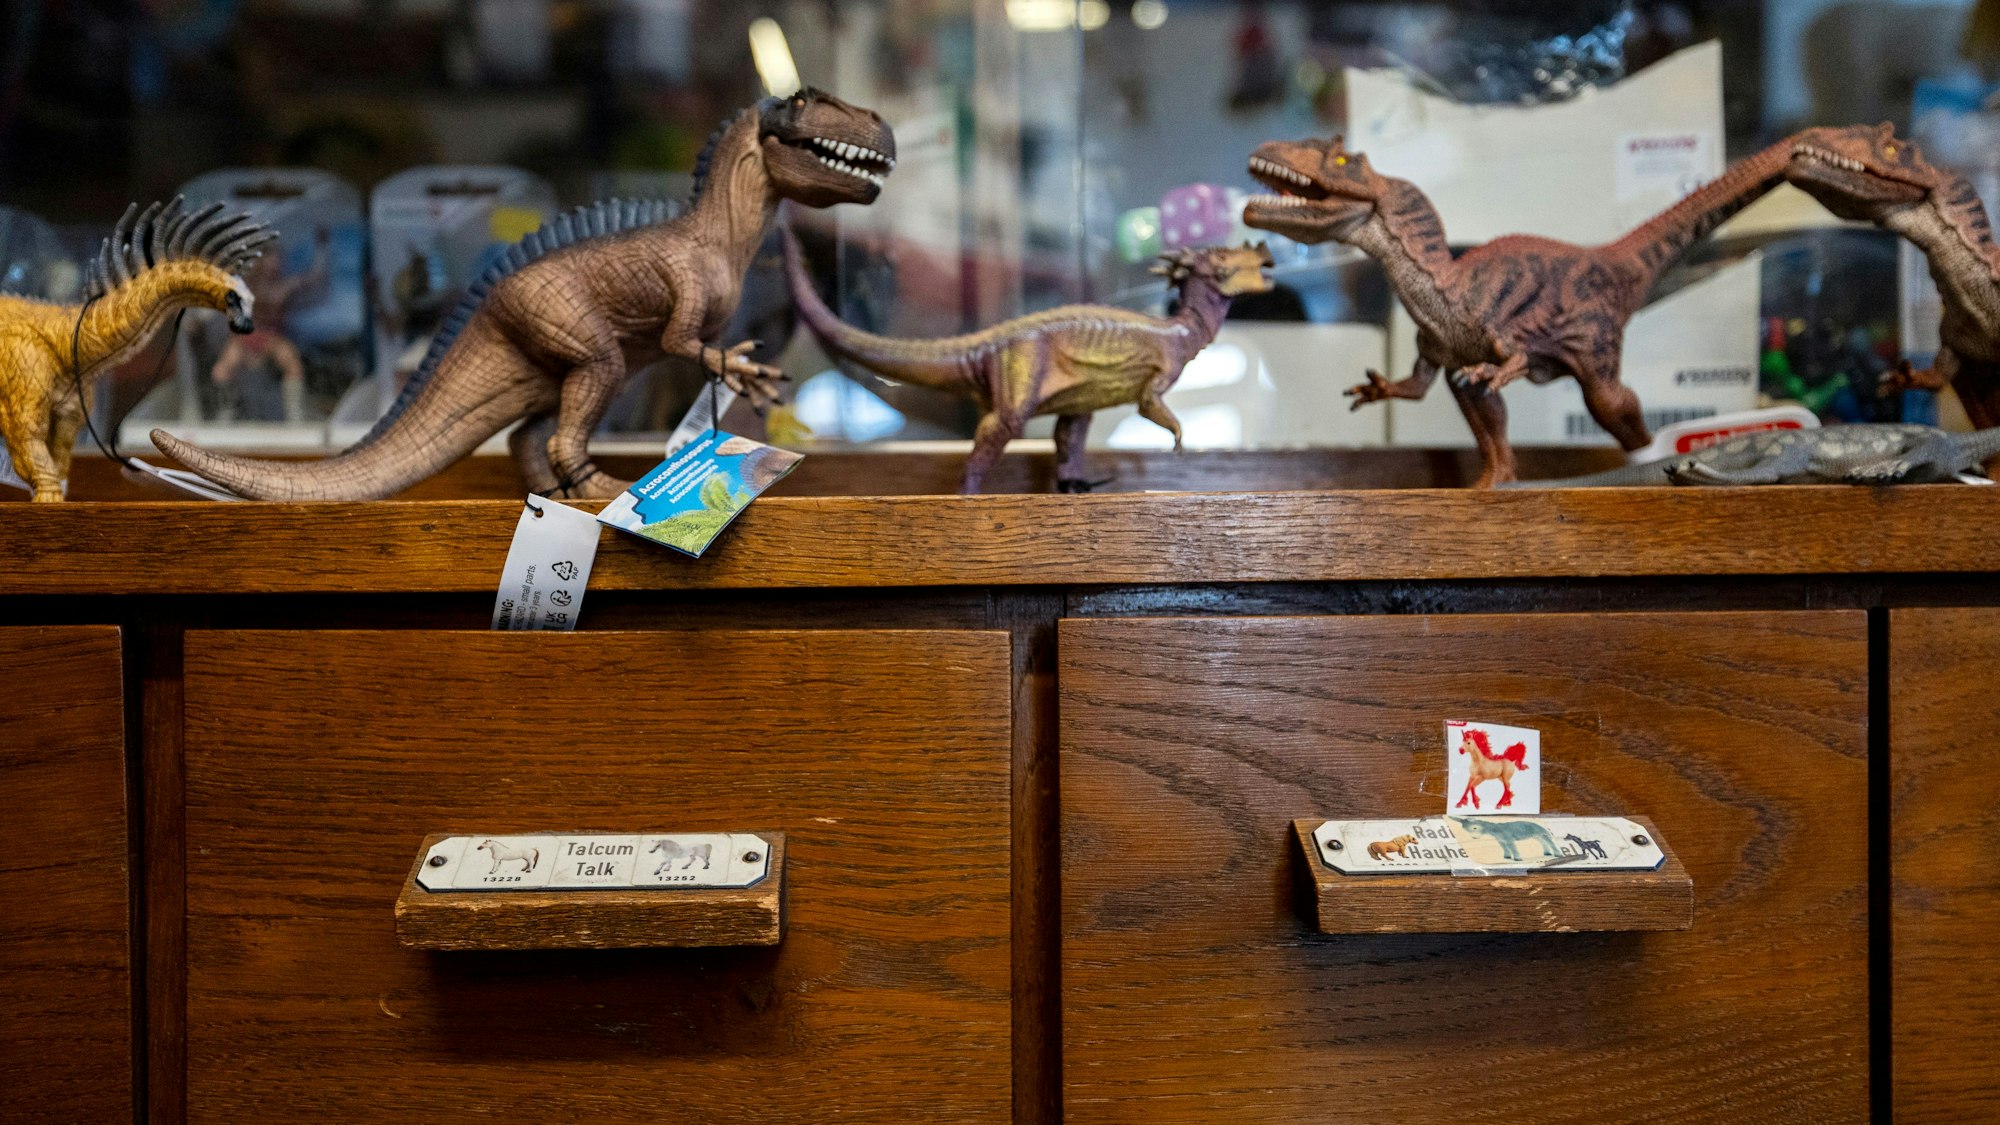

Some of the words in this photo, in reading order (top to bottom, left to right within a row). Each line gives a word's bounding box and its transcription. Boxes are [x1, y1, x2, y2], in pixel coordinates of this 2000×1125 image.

[638, 439, 714, 495] Acrocanthosaurus
[525, 563, 537, 586] parts.
[560, 565, 567, 574] 22
[571, 566, 579, 580] PAP
[520, 584, 532, 603] small
[544, 610, 557, 623] UK
[1412, 825, 1456, 839] Radi
[567, 842, 634, 856] Talcum
[1408, 845, 1469, 859] Hauhe
[1560, 843, 1578, 857] el
[576, 862, 615, 876] Talk
